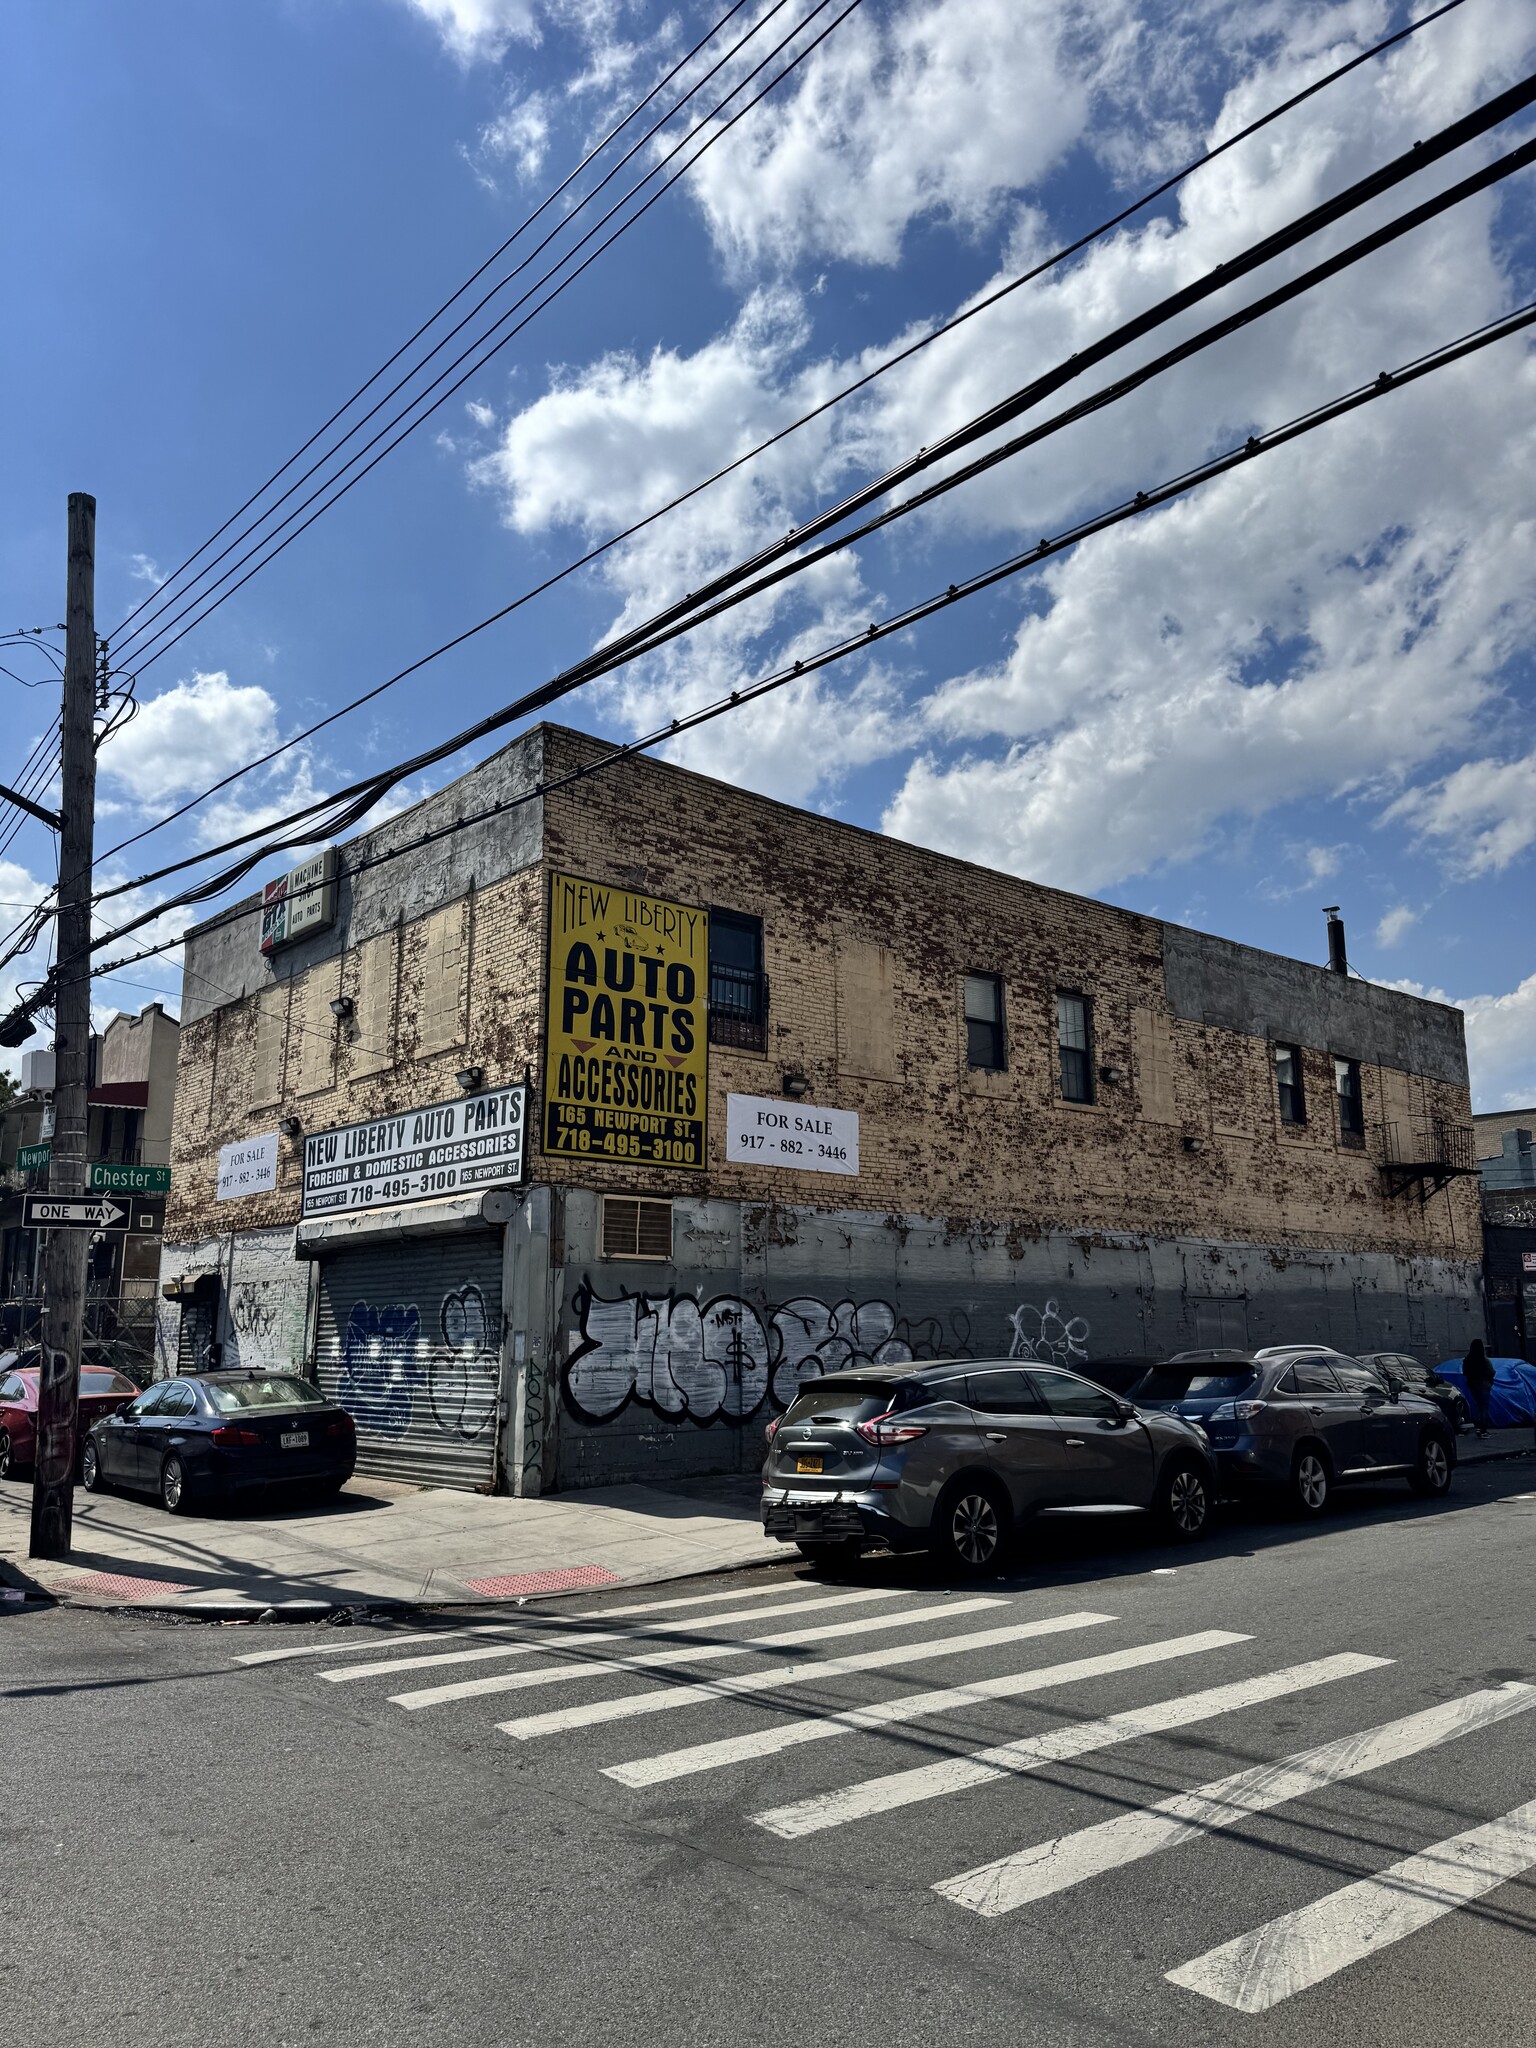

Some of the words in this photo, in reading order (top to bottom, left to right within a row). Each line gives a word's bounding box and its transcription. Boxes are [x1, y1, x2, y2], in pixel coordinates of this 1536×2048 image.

[294, 860, 322, 888] MACHINE
[292, 910, 302, 925] AUTO
[307, 902, 320, 917] PARTS
[564, 882, 610, 934] NEW
[625, 896, 698, 958] LIBERTY
[566, 942, 695, 1004] AUTO
[562, 986, 694, 1054] PARTS
[605, 1046, 656, 1064] AND
[558, 1054, 696, 1116] ACCESSORIES
[308, 1136, 338, 1167] NEW
[345, 1120, 406, 1159] LIBERTY
[413, 1108, 454, 1145] AUTO
[464, 1091, 522, 1134] PARTS
[558, 1106, 586, 1124] 165
[594, 1110, 667, 1134] NEWPORT
[674, 1121, 695, 1138] ST.
[757, 1112, 789, 1129] FOR
[794, 1118, 832, 1135] SALE
[22, 1150, 50, 1166] Newpor
[230, 1152, 244, 1166] FOR
[246, 1147, 265, 1162] SALE
[556, 1127, 696, 1162] 718-495-3100
[741, 1134, 764, 1149] 917
[780, 1140, 803, 1154] 882
[818, 1144, 847, 1160] 3446
[309, 1168, 349, 1188] FOREIGN
[354, 1166, 360, 1180] &
[366, 1153, 423, 1178] DOMESTIC
[428, 1134, 516, 1165] ACCESSORIES
[462, 1170, 472, 1181] 165
[474, 1165, 504, 1179] NEWPORT
[508, 1162, 518, 1174] ST.
[94, 1167, 150, 1187] Chester
[156, 1170, 166, 1182] St
[222, 1176, 233, 1188] 917
[239, 1172, 250, 1184] 882
[256, 1166, 270, 1180] 3446
[316, 1194, 338, 1206] NEWPORT
[351, 1169, 457, 1204] 718-495-3100
[40, 1206, 70, 1218] ONE
[84, 1207, 115, 1220] WAY
